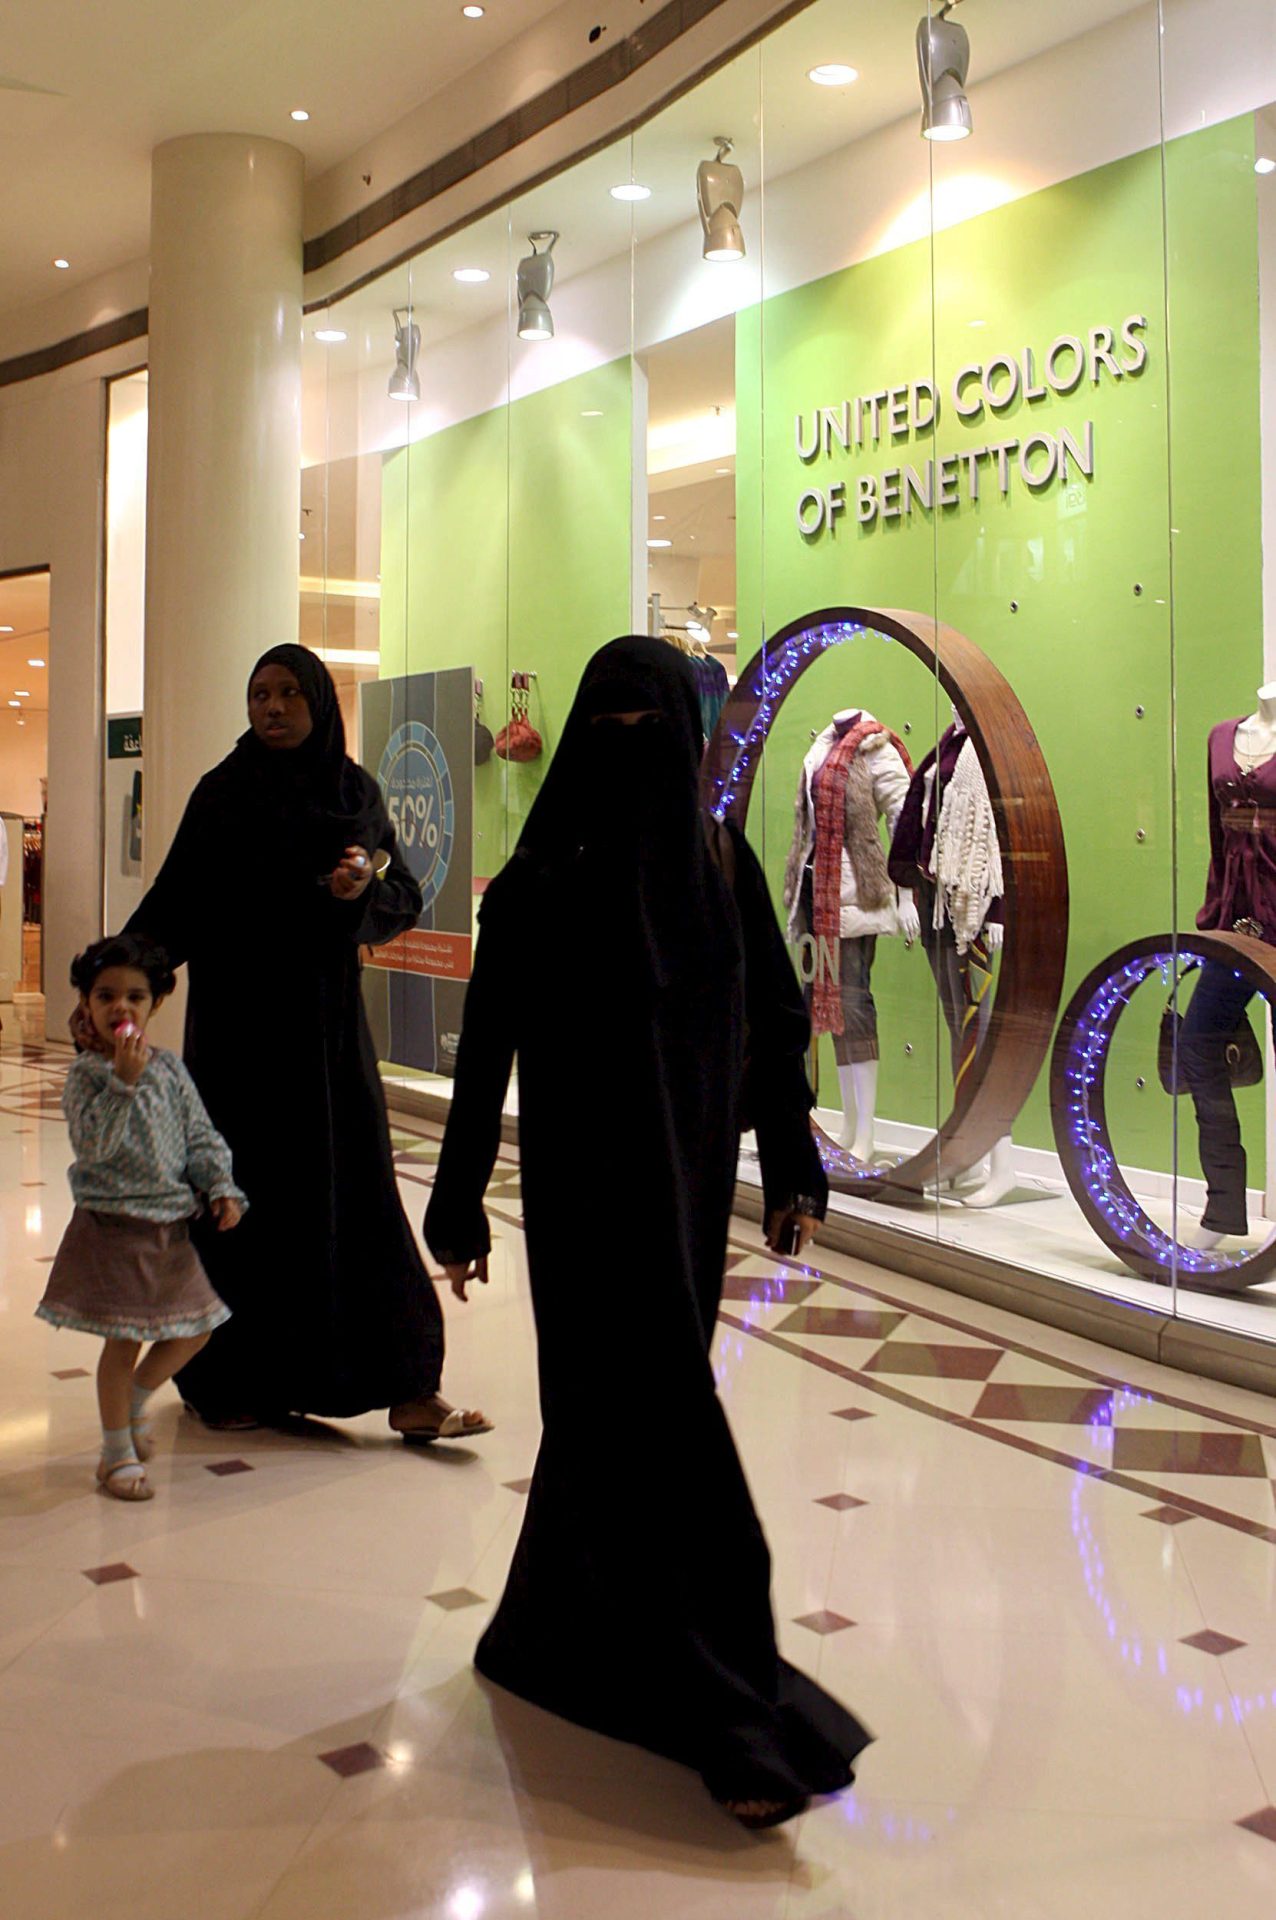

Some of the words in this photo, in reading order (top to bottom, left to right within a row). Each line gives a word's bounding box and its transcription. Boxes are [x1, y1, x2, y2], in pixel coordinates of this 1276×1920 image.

[794, 378, 940, 461] UNITED
[951, 314, 1148, 417] COLORS
[795, 482, 846, 536] OF
[856, 420, 1094, 524] BENETTON
[388, 794, 438, 848] 50%
